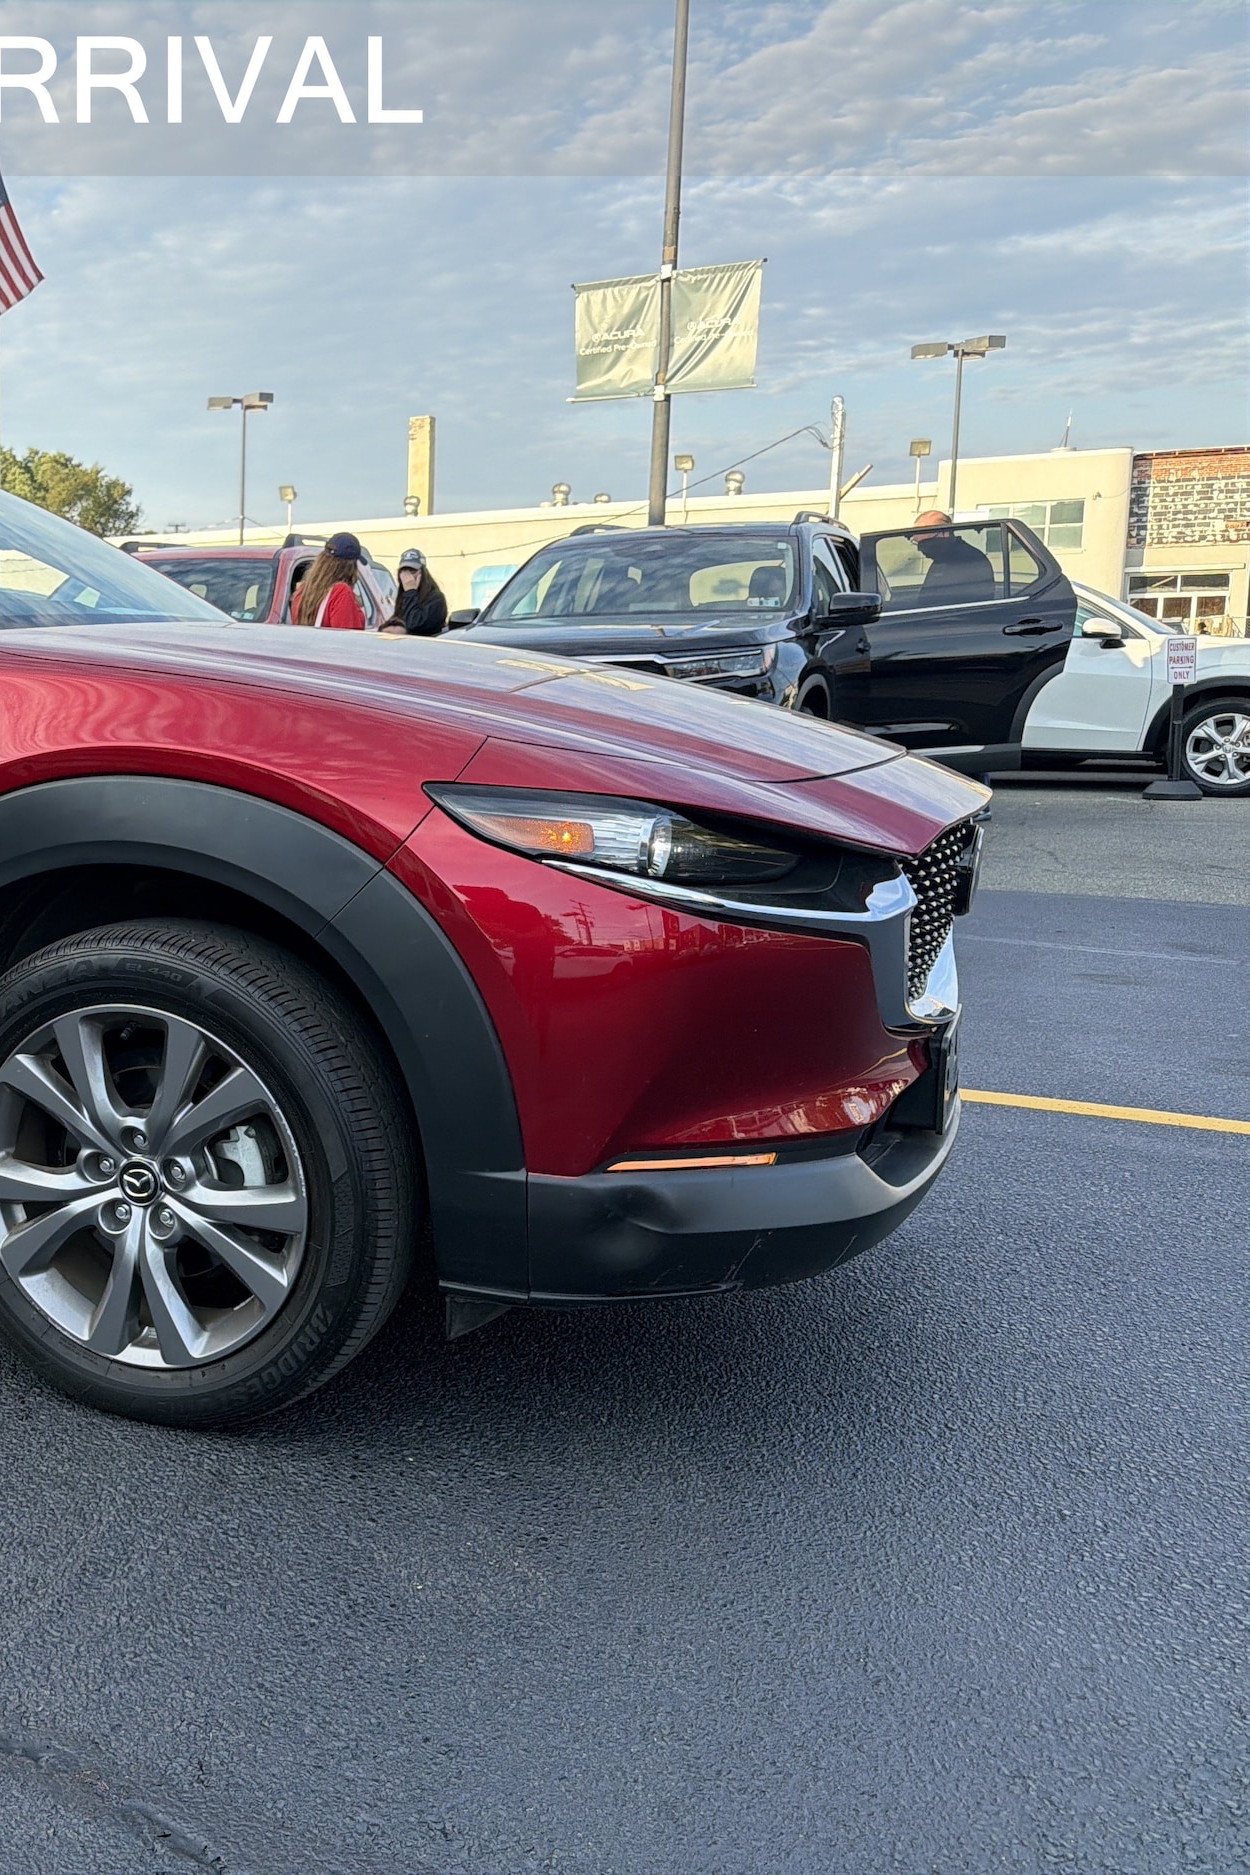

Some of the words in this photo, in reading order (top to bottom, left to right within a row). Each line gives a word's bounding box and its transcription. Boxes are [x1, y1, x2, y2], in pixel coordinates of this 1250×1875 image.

[602, 328, 645, 342] ACURA
[579, 345, 612, 356] Certified
[613, 340, 657, 352] Pre-Owned
[1170, 642, 1195, 651] CUSTOMER
[1169, 655, 1194, 664] PARKING
[1174, 671, 1190, 679] ONLY
[125, 962, 182, 983] EL440
